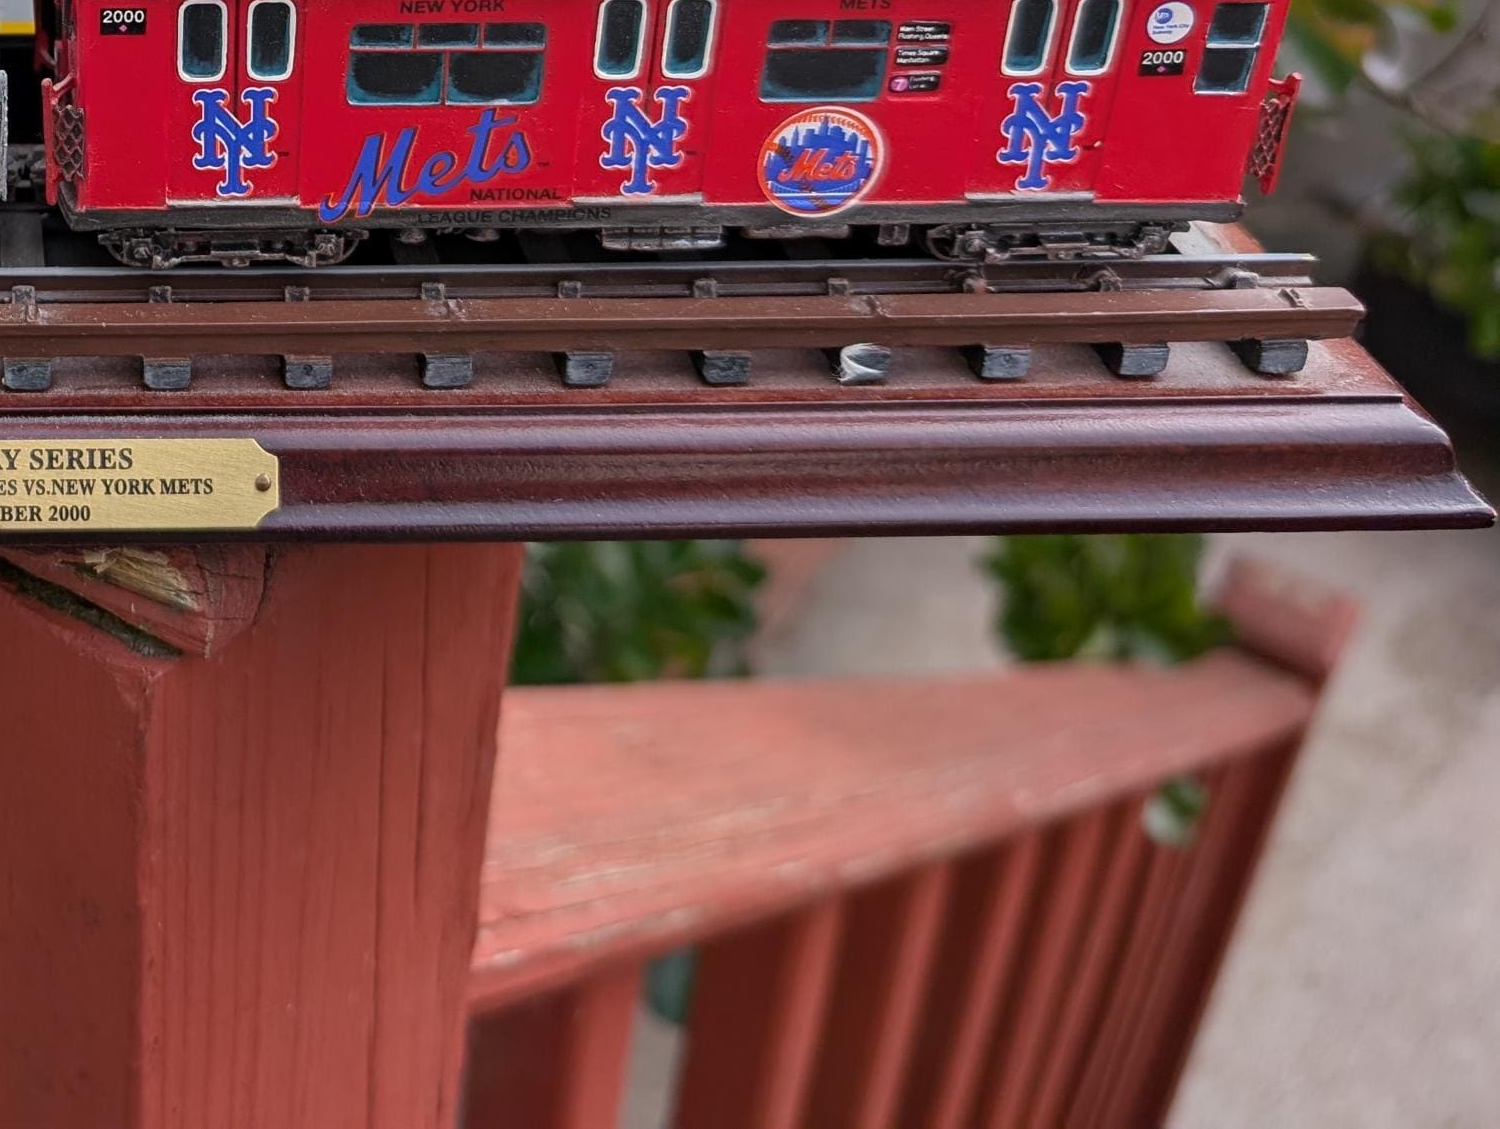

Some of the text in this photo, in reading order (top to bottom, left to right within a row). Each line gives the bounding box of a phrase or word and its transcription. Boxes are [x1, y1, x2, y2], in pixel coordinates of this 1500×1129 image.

[400, 0, 505, 14] NEW YORK
[102, 10, 145, 24] 2000
[1142, 51, 1184, 65] 2000
[319, 108, 531, 222] Mets
[777, 148, 860, 182] Mets
[470, 188, 561, 201] NATIONAL
[419, 207, 612, 223] LEAGUE CHAMPIONS
[29, 447, 133, 470] SERIES
[100, 478, 156, 495] YORK
[159, 477, 214, 495] METS
[48, 505, 91, 521] 2000
